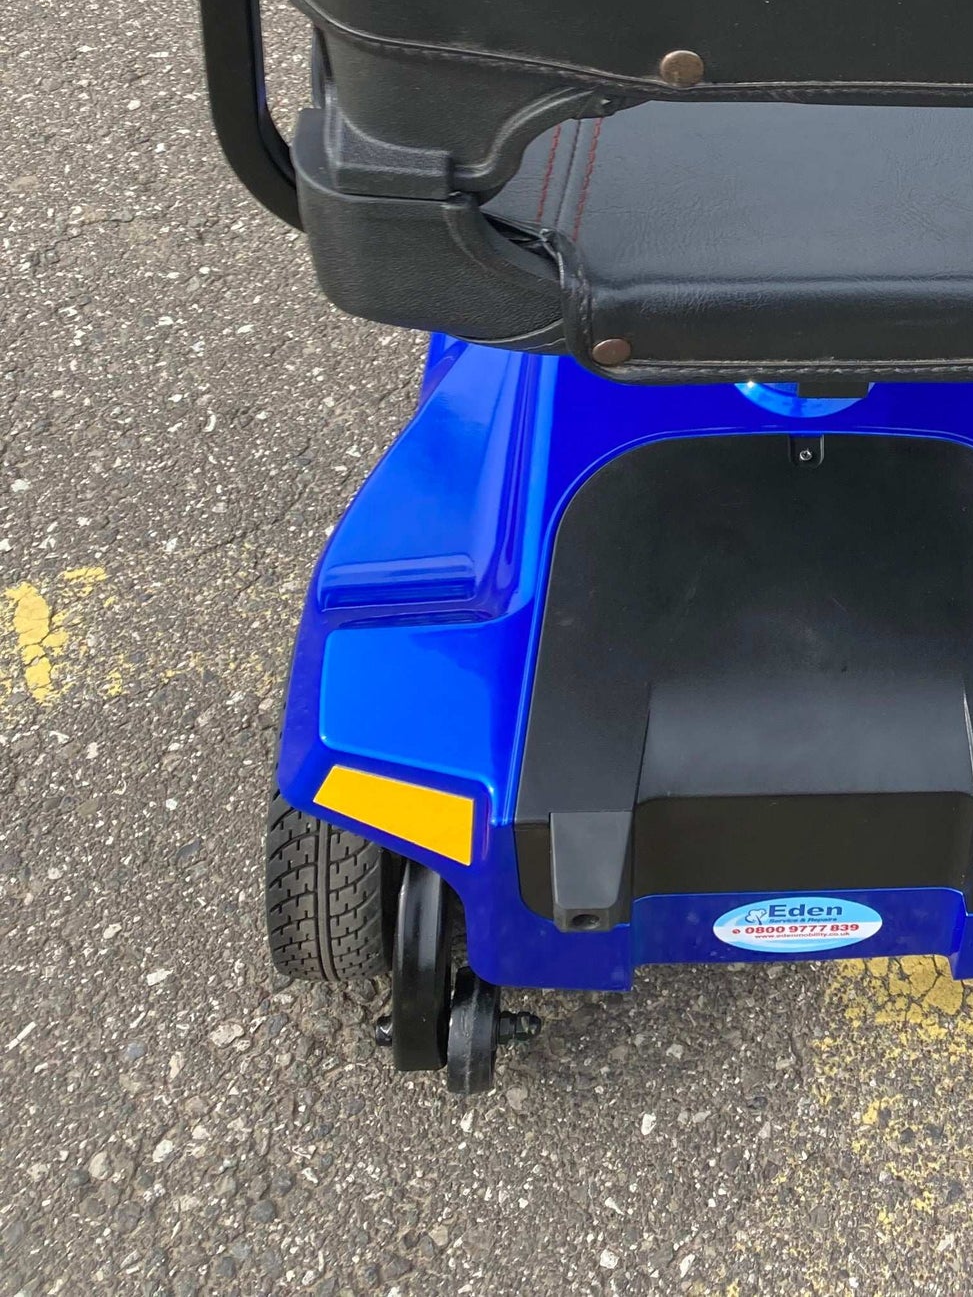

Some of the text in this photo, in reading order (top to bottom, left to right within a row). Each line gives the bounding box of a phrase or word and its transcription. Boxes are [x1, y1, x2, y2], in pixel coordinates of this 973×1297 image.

[768, 903, 843, 918] Eden
[745, 923, 860, 934] 0800 9777 839
[754, 931, 850, 939] www.edenmobility.co.uk
